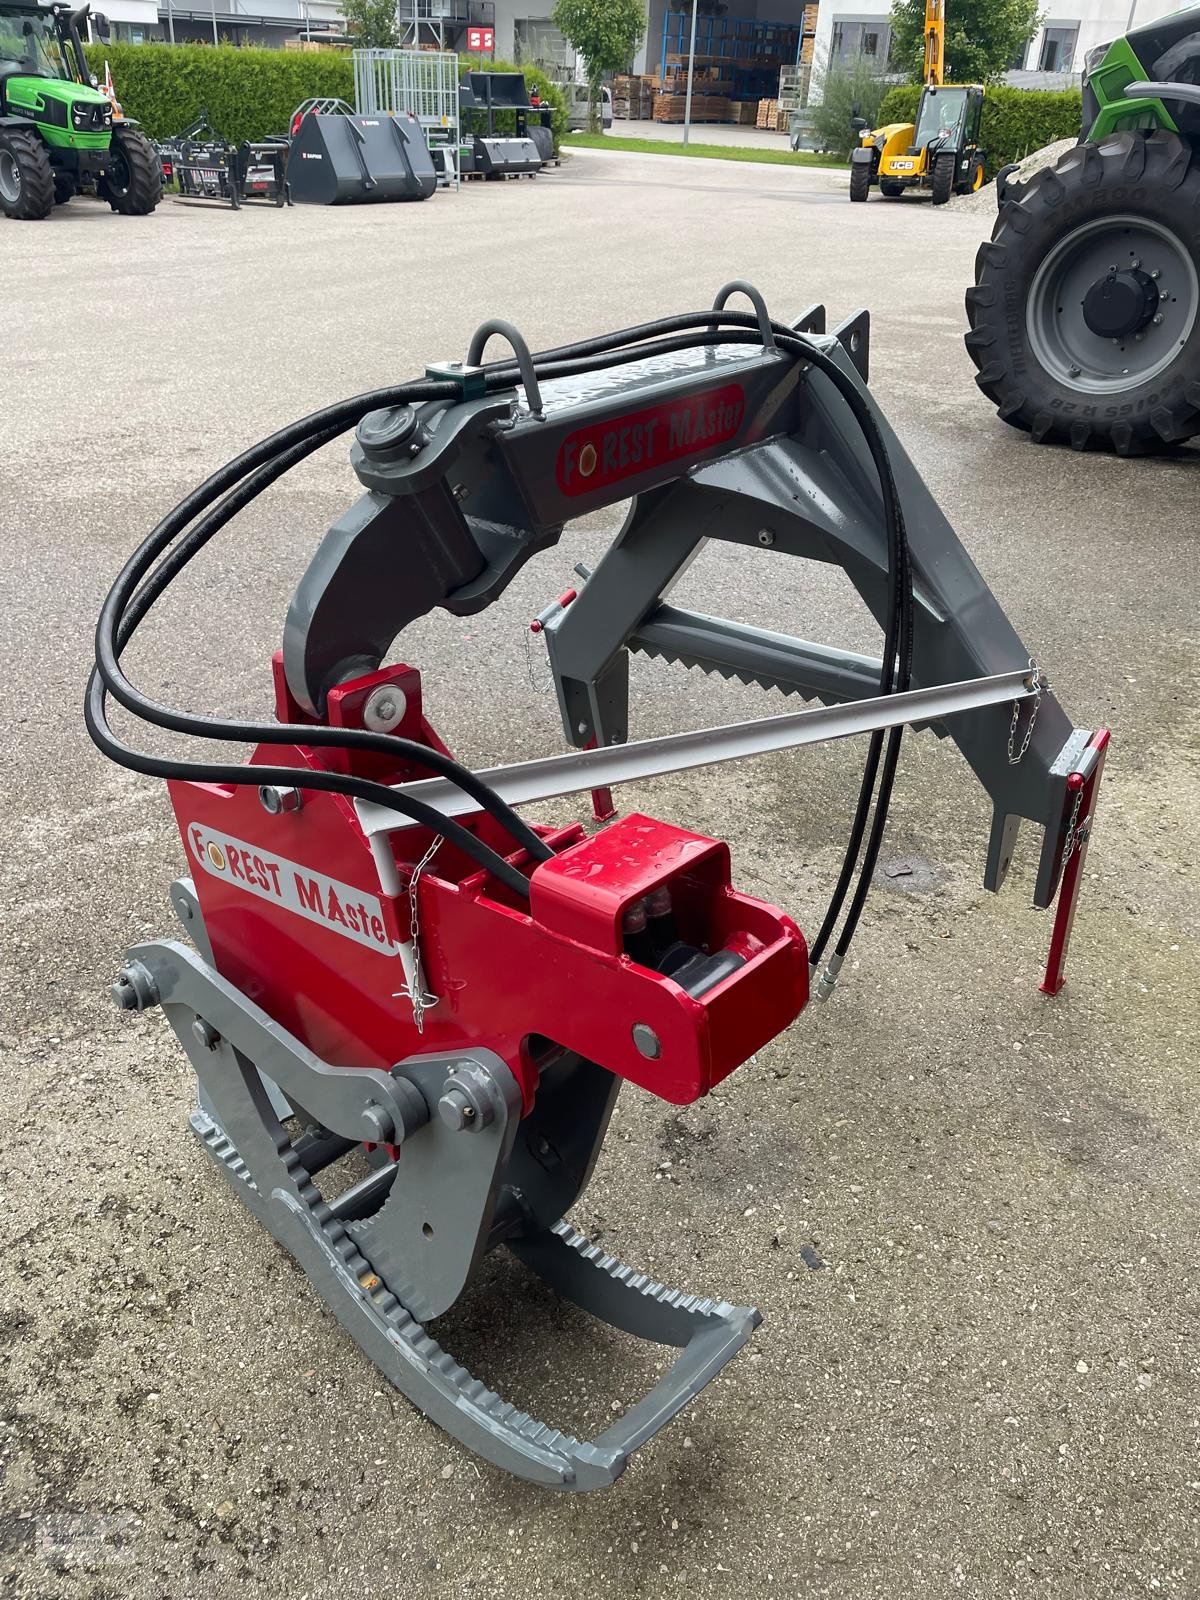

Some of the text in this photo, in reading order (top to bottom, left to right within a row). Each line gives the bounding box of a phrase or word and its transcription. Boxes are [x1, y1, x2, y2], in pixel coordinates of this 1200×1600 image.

[889, 161, 914, 170] JCB
[562, 418, 660, 487] FOREST
[191, 827, 283, 898] FOREST
